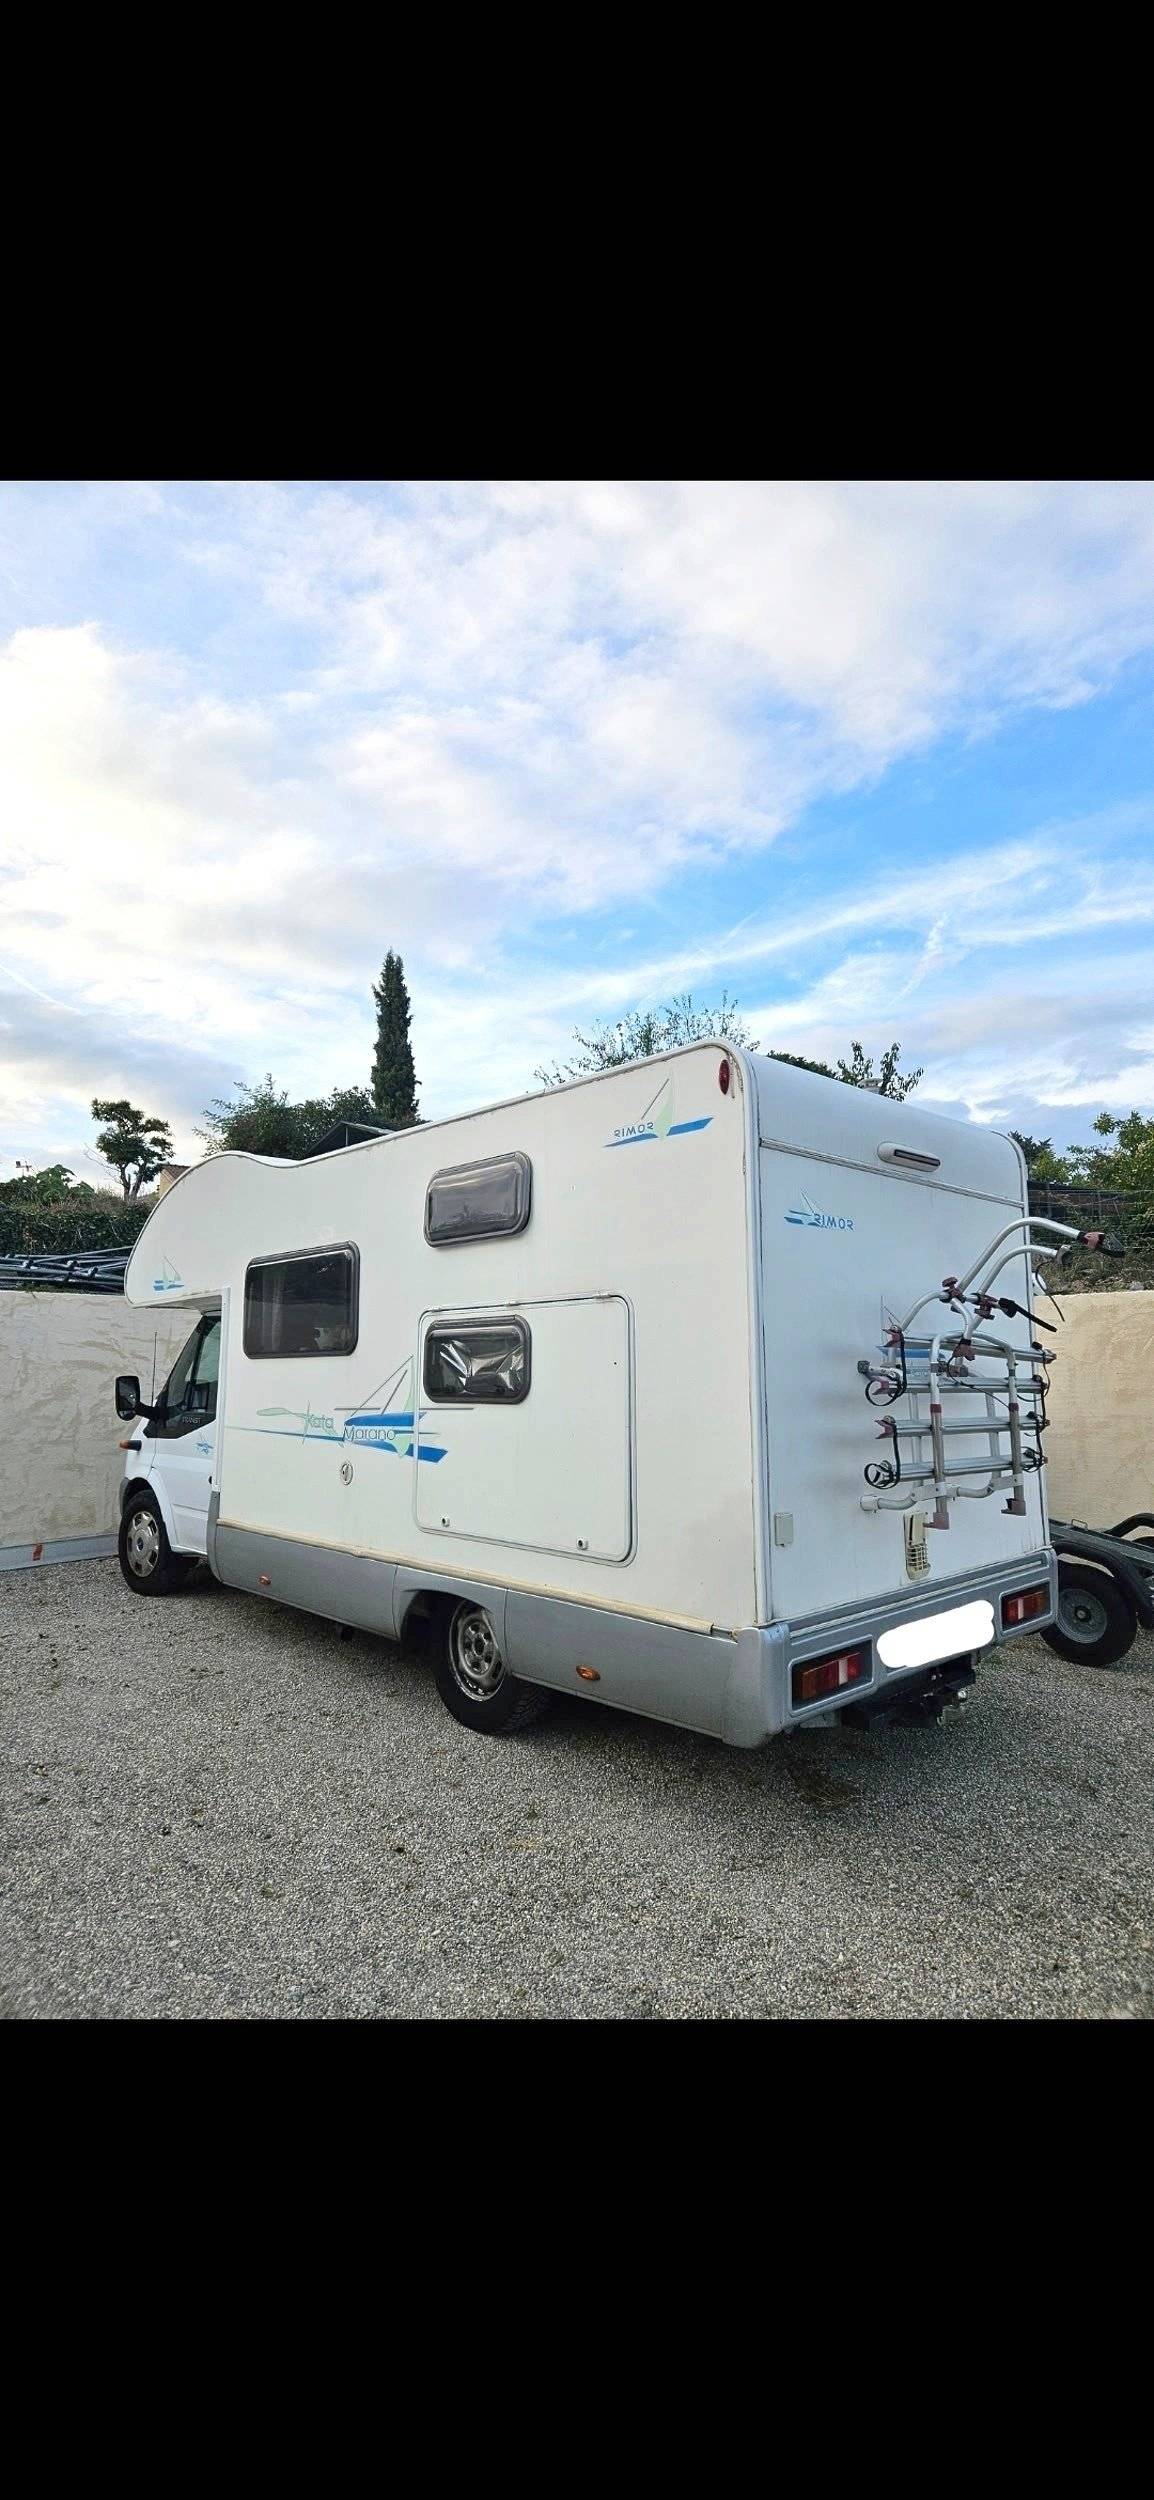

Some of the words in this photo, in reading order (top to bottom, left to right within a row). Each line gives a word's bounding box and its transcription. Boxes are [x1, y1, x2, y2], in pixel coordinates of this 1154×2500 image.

[613, 1122, 655, 1138] RIMOR
[814, 1213, 855, 1231] RIMOR
[342, 1425, 396, 1442] Marano
